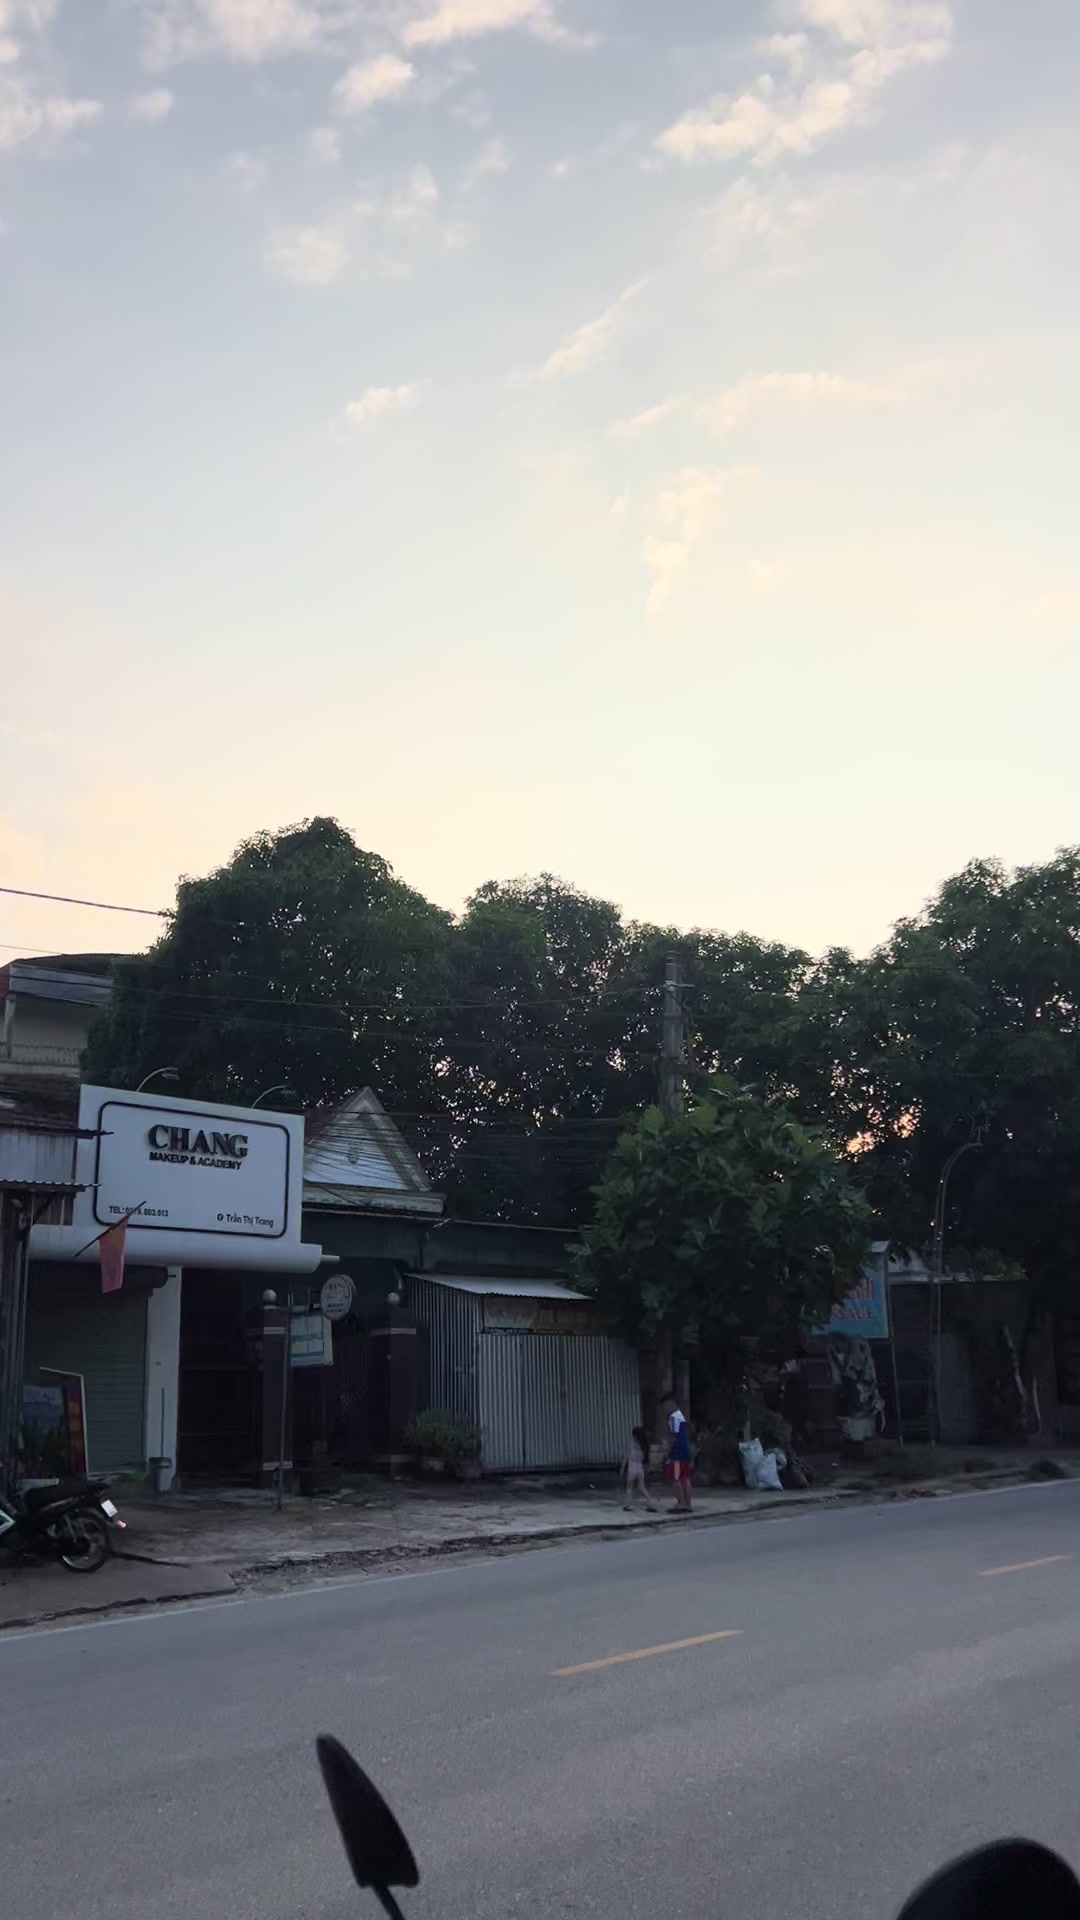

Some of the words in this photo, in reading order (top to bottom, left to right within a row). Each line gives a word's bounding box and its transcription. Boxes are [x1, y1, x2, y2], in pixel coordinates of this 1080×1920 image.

[147, 1124, 248, 1158] CHANG
[149, 1151, 189, 1164] MAKEUP
[190, 1156, 196, 1165] &
[197, 1156, 242, 1170] ACADEMY
[255, 1216, 274, 1229] Trang
